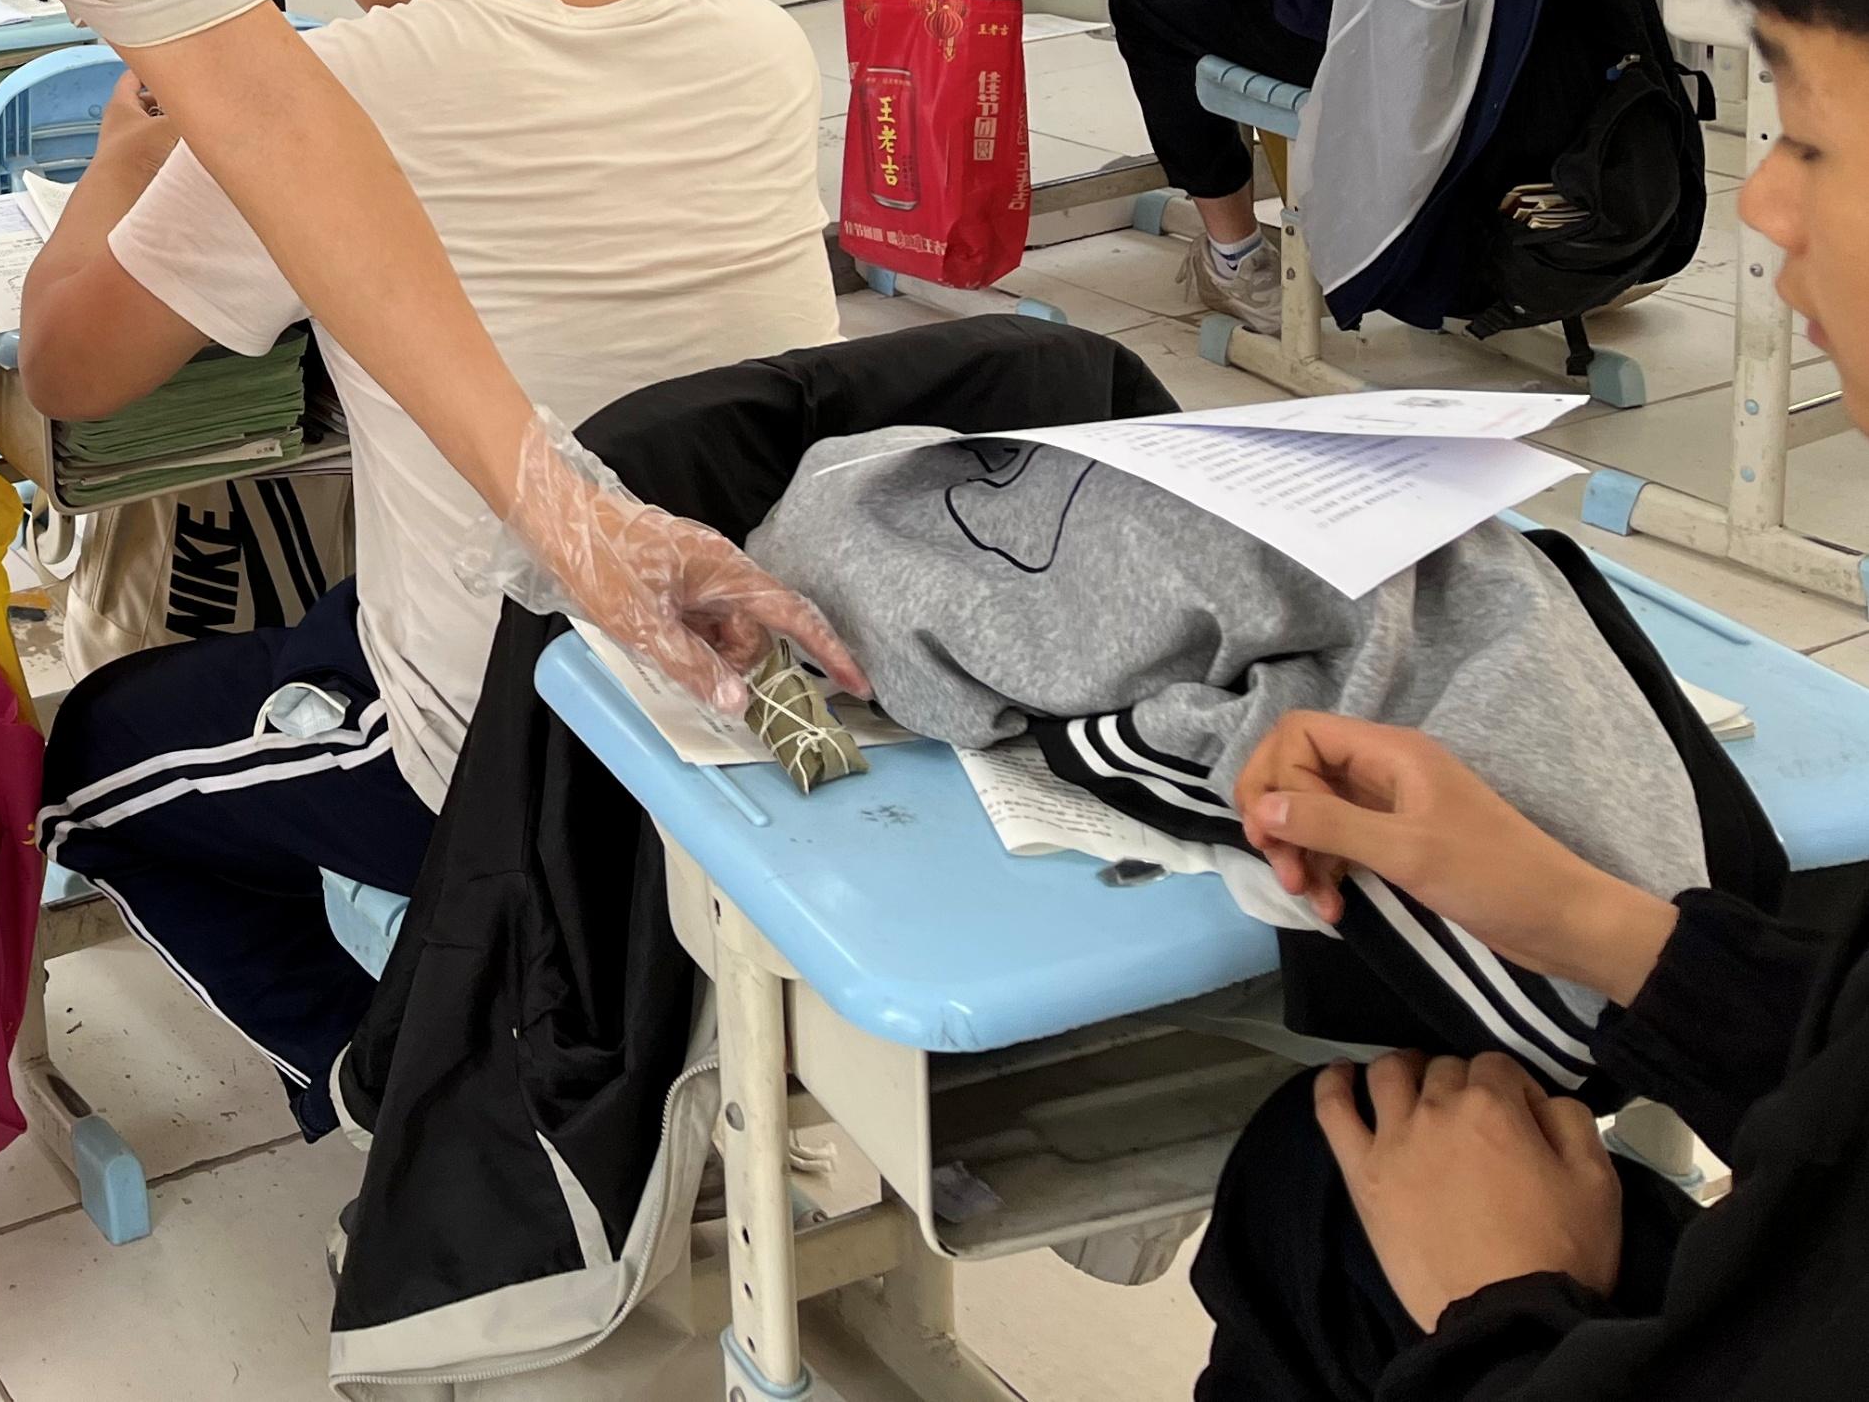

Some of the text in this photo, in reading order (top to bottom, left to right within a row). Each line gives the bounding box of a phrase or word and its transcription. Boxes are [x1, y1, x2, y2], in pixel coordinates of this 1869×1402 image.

[978, 23, 1009, 37] 王老吉
[877, 95, 900, 187] 王老吉
[166, 503, 242, 638] NIKE
